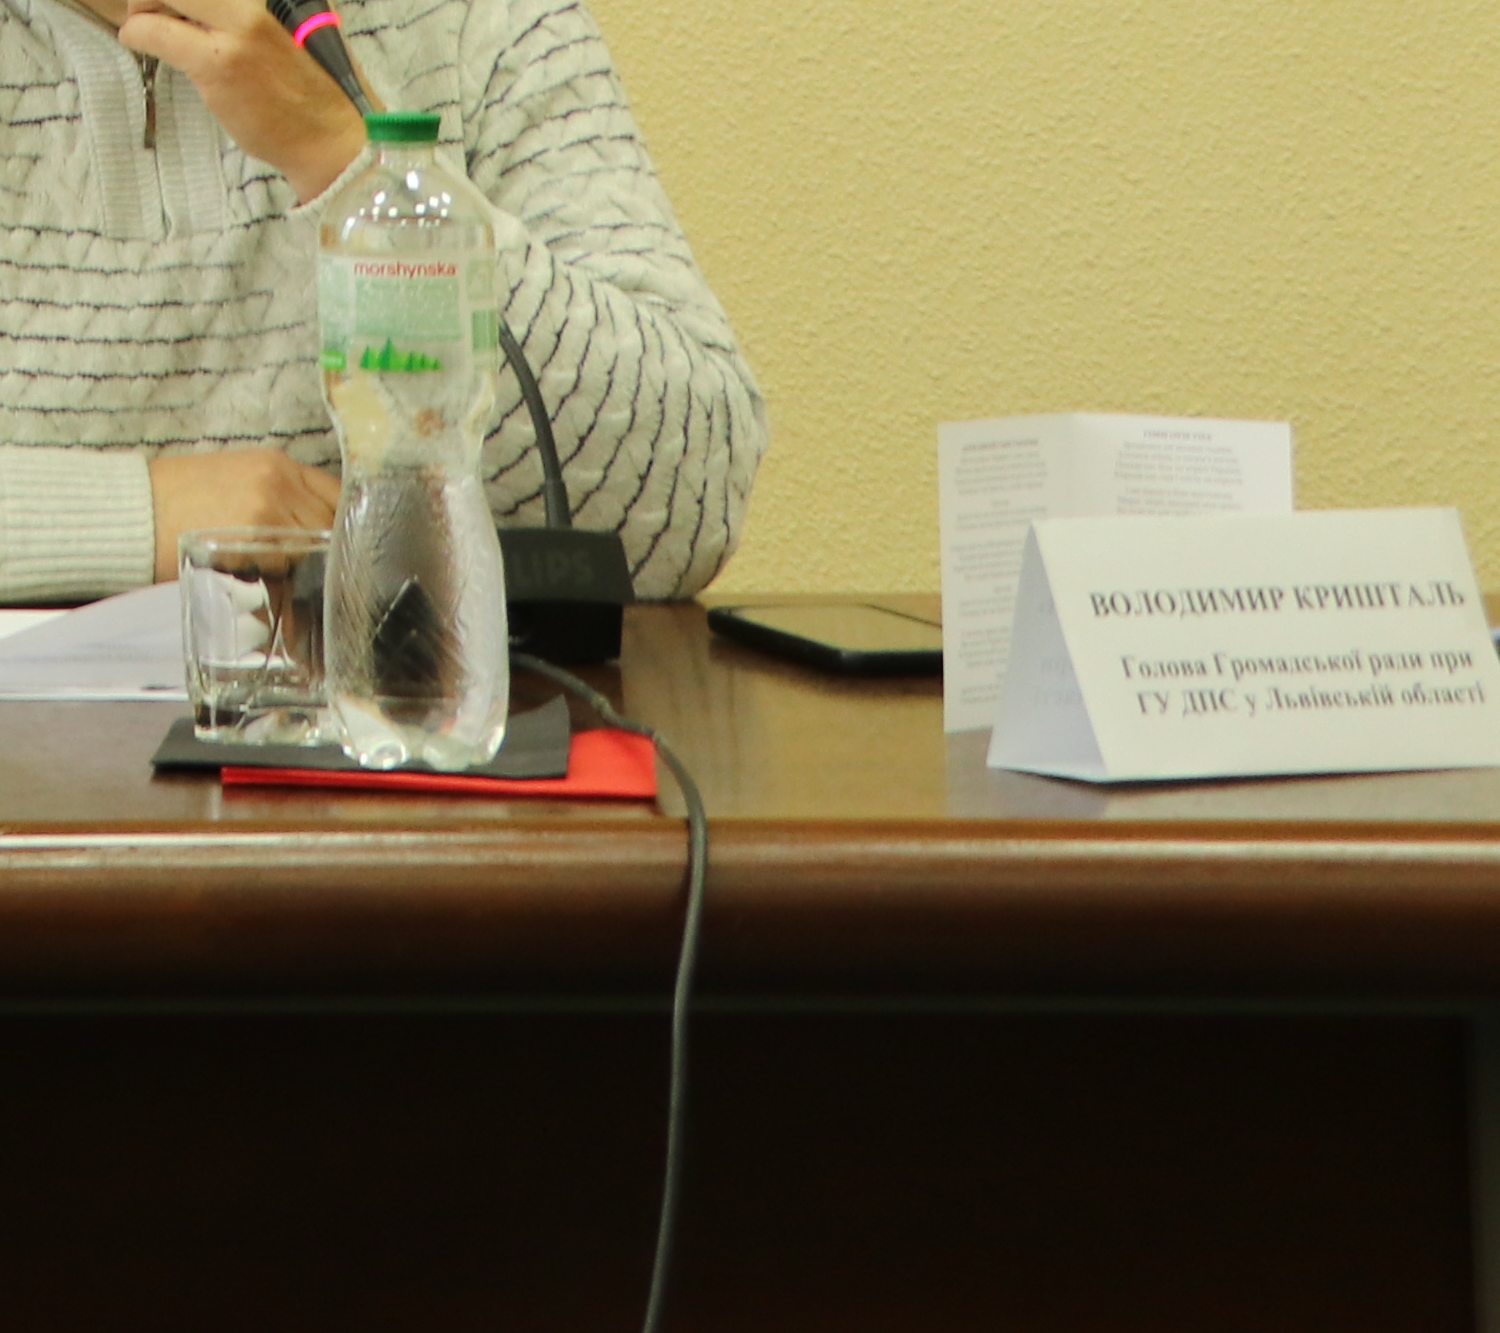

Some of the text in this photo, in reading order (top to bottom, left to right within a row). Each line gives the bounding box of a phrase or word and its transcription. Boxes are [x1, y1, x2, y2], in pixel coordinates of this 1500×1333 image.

[354, 261, 458, 280] morshynska
[511, 549, 594, 589] LIPS
[1089, 586, 1286, 618] ВОЛОДИМИР
[1292, 581, 1467, 611] КРИШТАЛЬ
[1120, 649, 1474, 682] Голова Громадської ради при
[1136, 681, 1486, 717] ГУ ДПС у Львівській області
